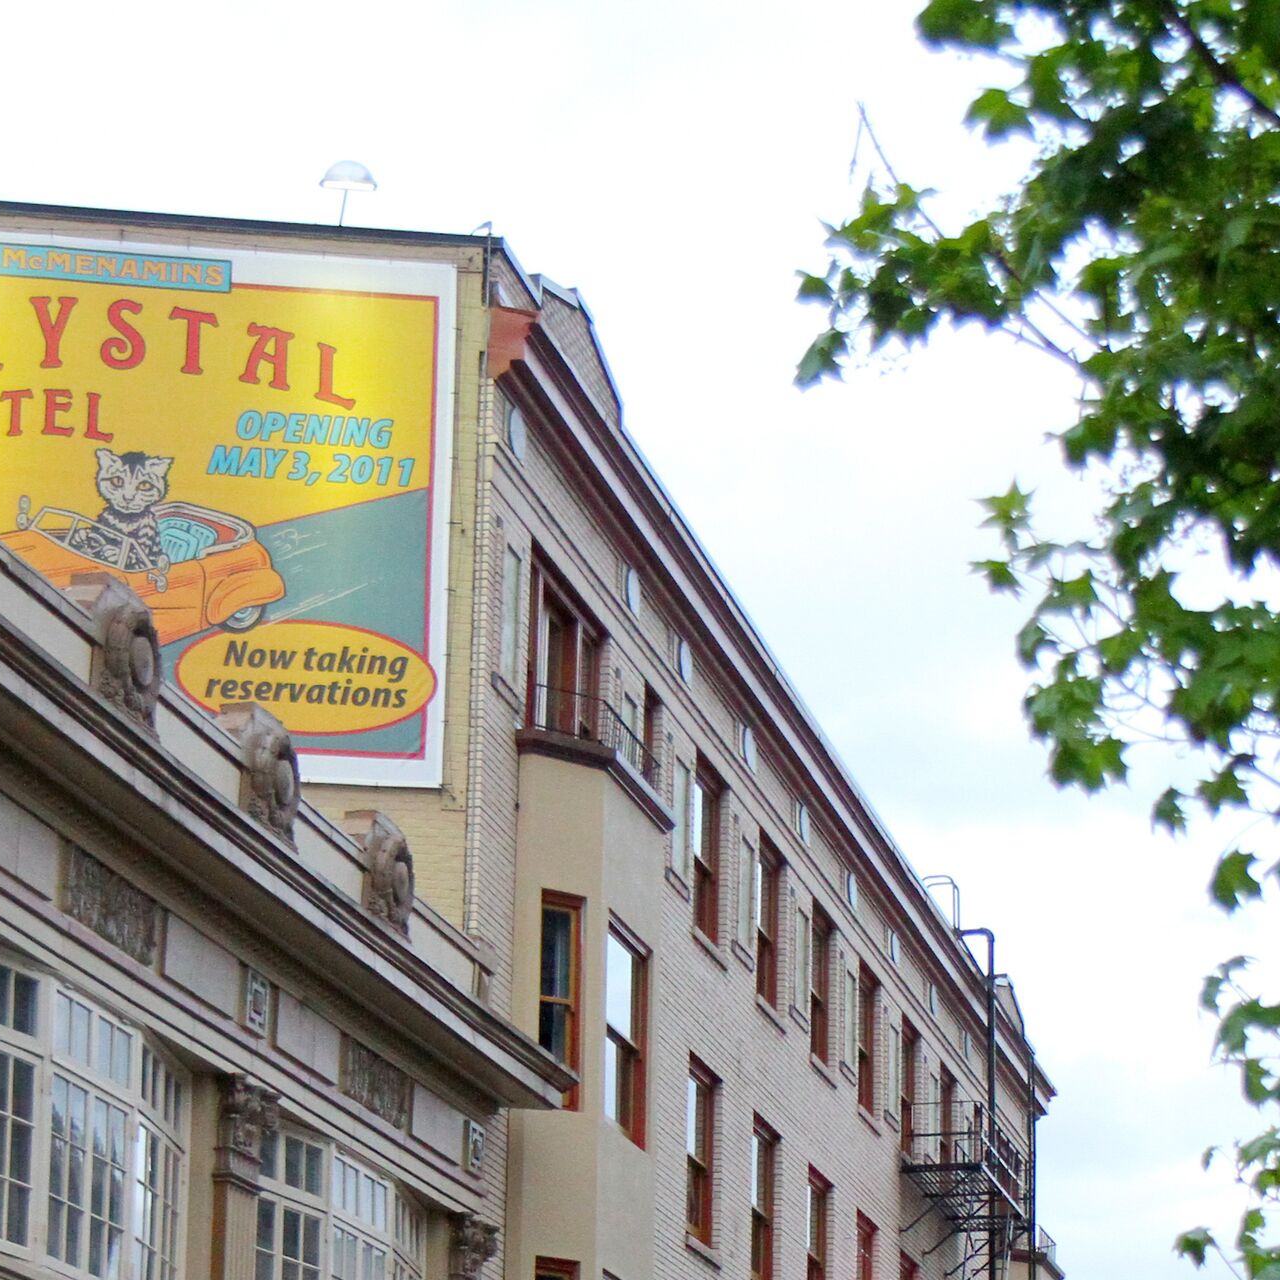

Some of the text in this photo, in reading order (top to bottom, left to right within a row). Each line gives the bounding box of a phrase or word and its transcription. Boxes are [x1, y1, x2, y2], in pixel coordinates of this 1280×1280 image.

[236, 409, 394, 449] OPENING
[206, 445, 417, 488] MAY 3, 2011
[223, 640, 410, 678] Now taking
[204, 677, 407, 710] reservations
